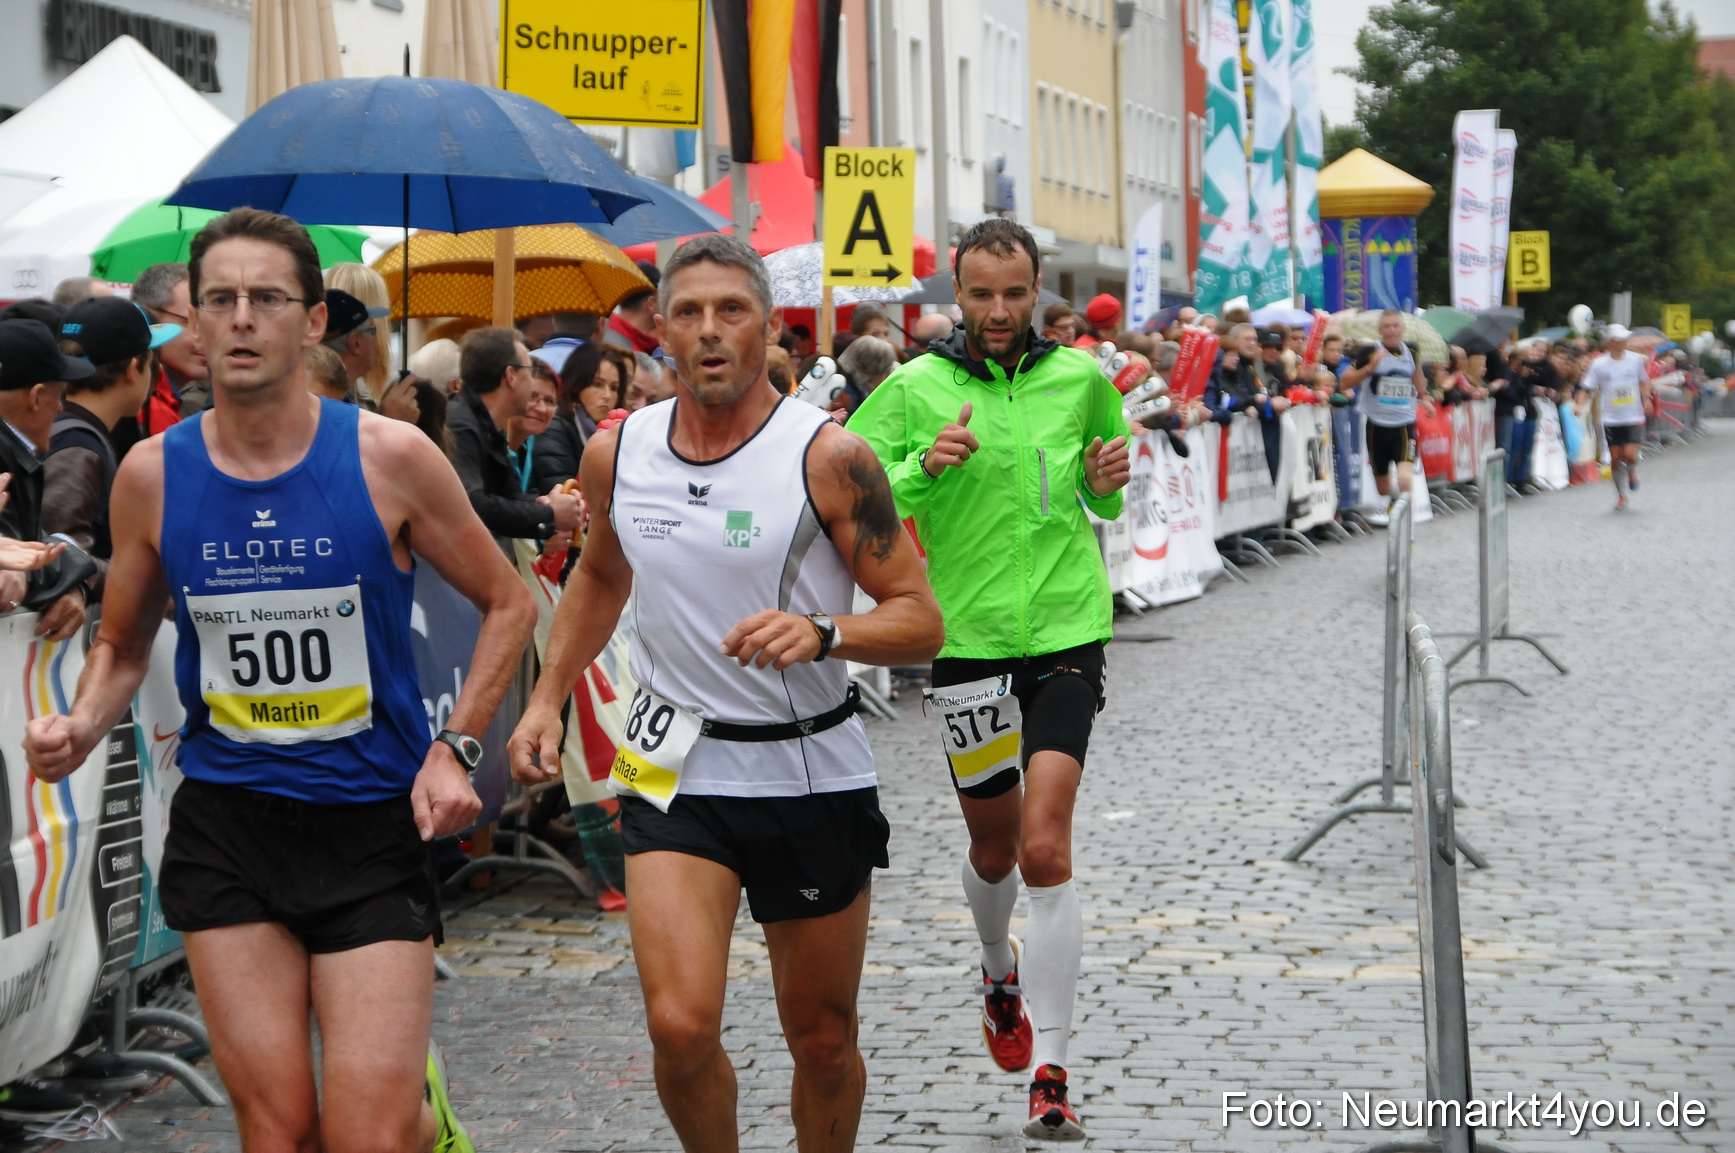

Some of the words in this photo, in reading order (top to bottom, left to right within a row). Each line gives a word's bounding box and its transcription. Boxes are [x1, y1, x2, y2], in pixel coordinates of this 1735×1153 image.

[514, 22, 688, 60] Schnupper-
[573, 63, 629, 91] lauf
[835, 152, 904, 178] Block
[841, 189, 893, 256] A
[1515, 234, 1545, 246] Block
[1521, 250, 1541, 276] B
[638, 525, 673, 535] LANGE
[202, 537, 333, 561] ELOTEC
[193, 610, 248, 625] PARTL
[250, 605, 330, 622] Neumarkt
[228, 628, 332, 688] 500
[949, 690, 994, 707] Neumarkt
[250, 701, 320, 723] Martin
[624, 687, 676, 753] 89
[944, 705, 1012, 749] 572
[111, 852, 134, 873] Freizeit
